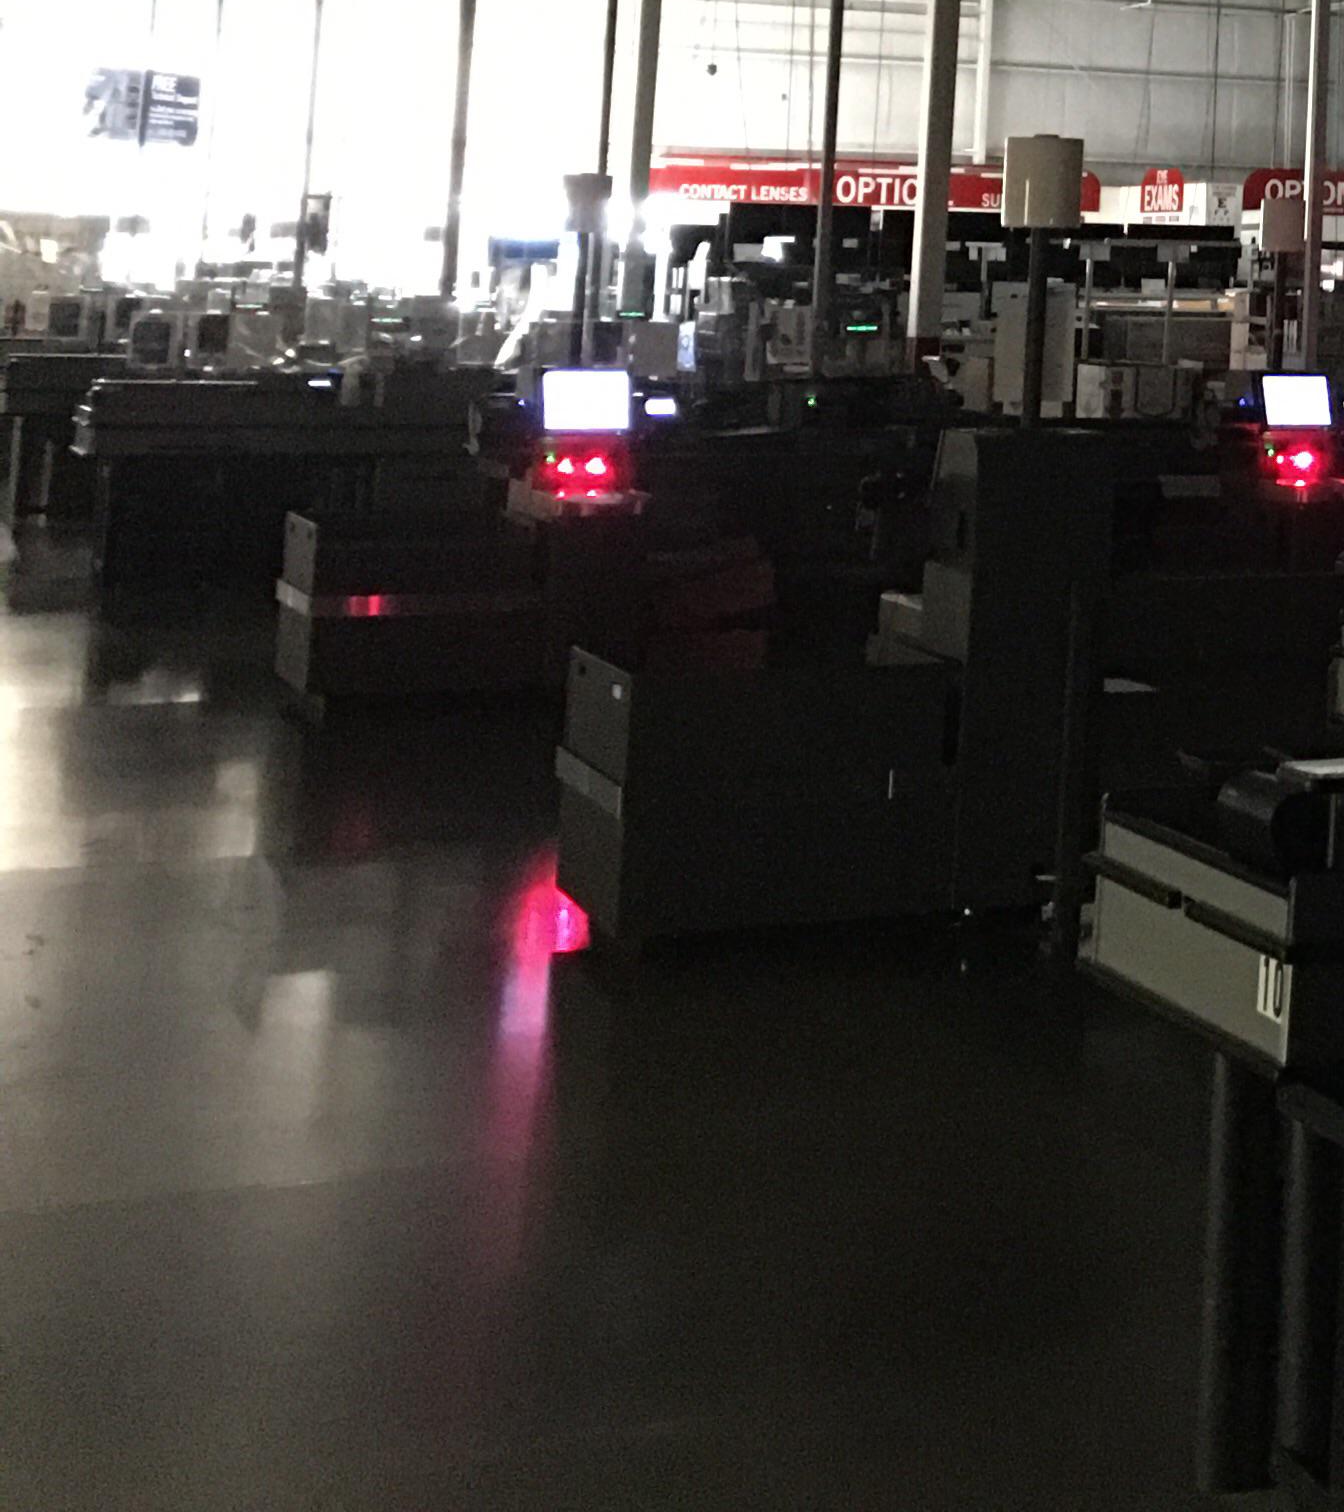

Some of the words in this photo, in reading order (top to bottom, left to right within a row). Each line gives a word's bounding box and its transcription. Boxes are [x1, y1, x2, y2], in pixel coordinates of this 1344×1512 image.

[679, 183, 747, 201] CONTACT
[750, 185, 809, 202] LENSES
[836, 175, 940, 206] OPTIC
[1143, 184, 1180, 212] EXAMS
[1262, 955, 1284, 1019] 10
